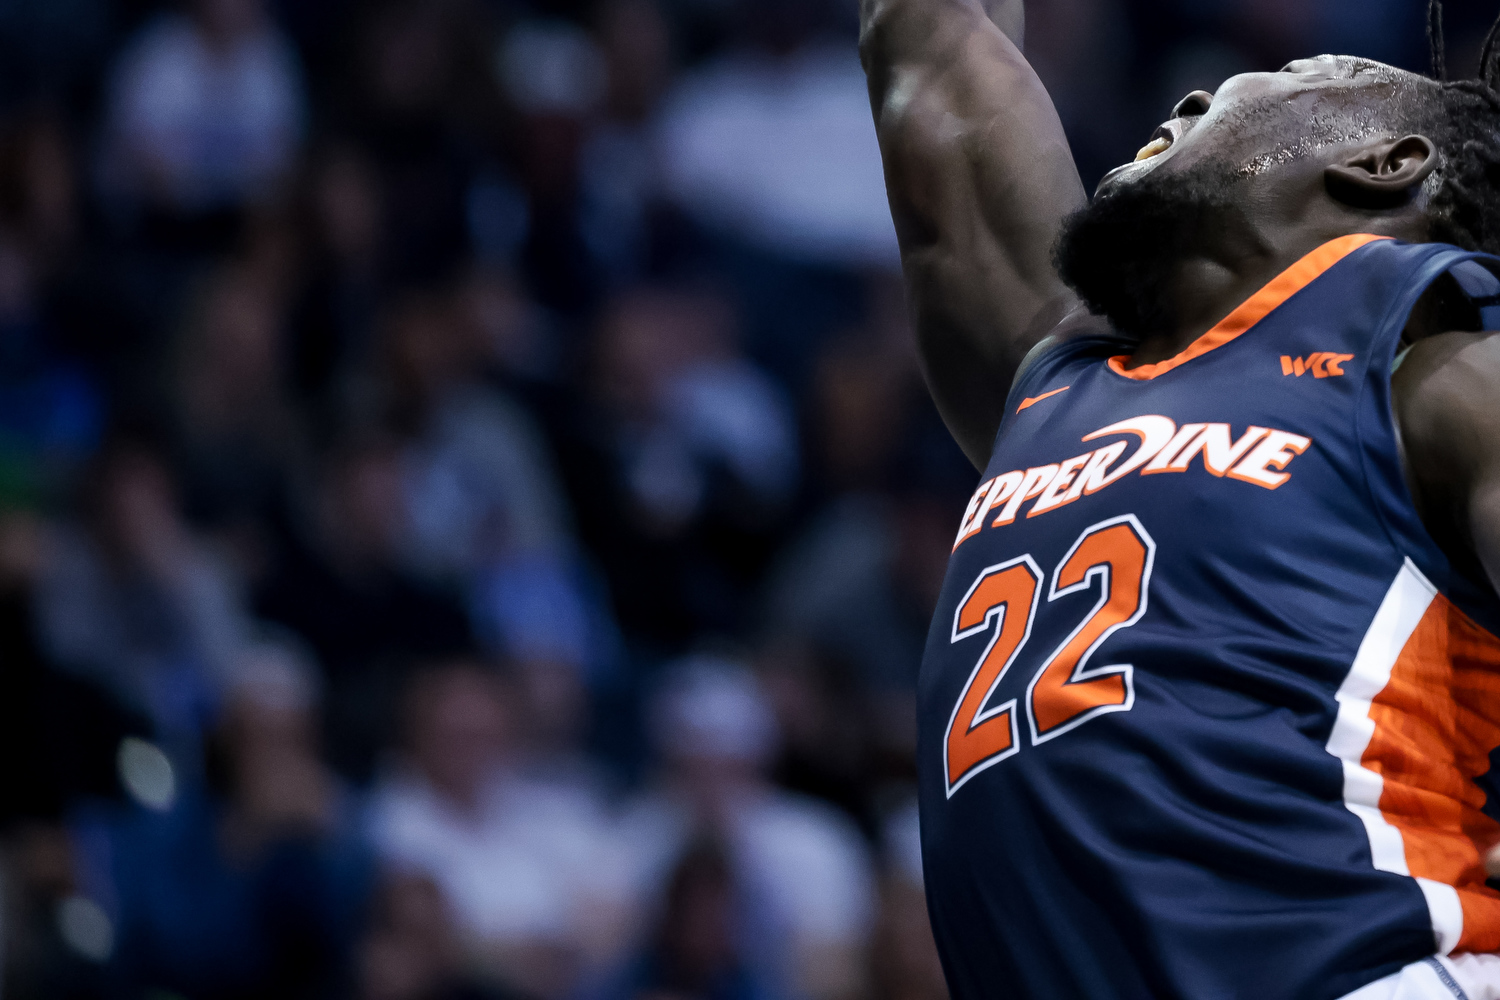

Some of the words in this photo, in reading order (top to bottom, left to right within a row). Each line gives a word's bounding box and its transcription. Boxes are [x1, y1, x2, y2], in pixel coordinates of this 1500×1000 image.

[1280, 351, 1356, 379] WCC
[951, 414, 1313, 553] EPPERDINE
[943, 513, 1157, 800] 22
